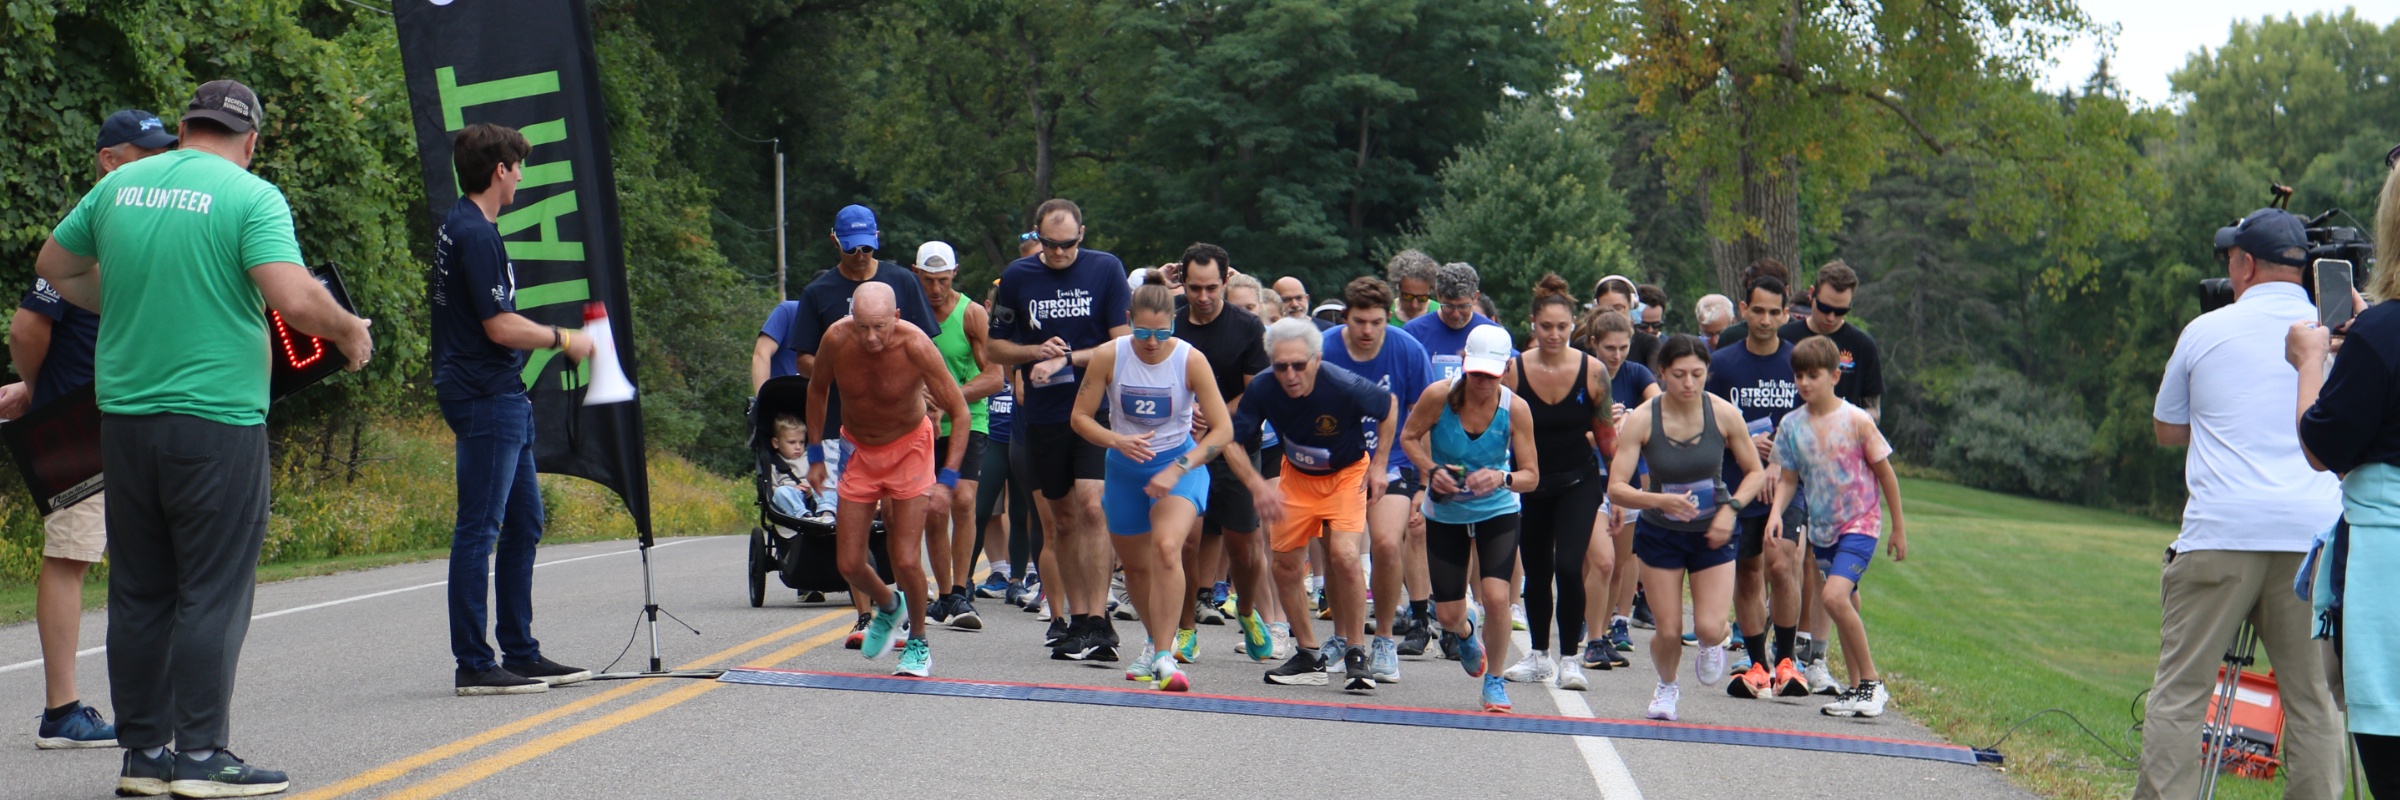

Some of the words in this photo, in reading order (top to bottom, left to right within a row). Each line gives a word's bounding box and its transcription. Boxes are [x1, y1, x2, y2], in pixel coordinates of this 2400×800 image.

[223, 101, 243, 114] RUNNING
[115, 186, 213, 215] VOLUNTEER
[1038, 296, 1093, 310] STROLLIN'
[1050, 306, 1091, 319] COLON
[1444, 366, 1462, 380] 54
[1740, 387, 1799, 399] STROLLIN'
[1135, 399, 1156, 415] 22
[1753, 397, 1795, 409] COLON
[1295, 452, 1315, 465] 56
